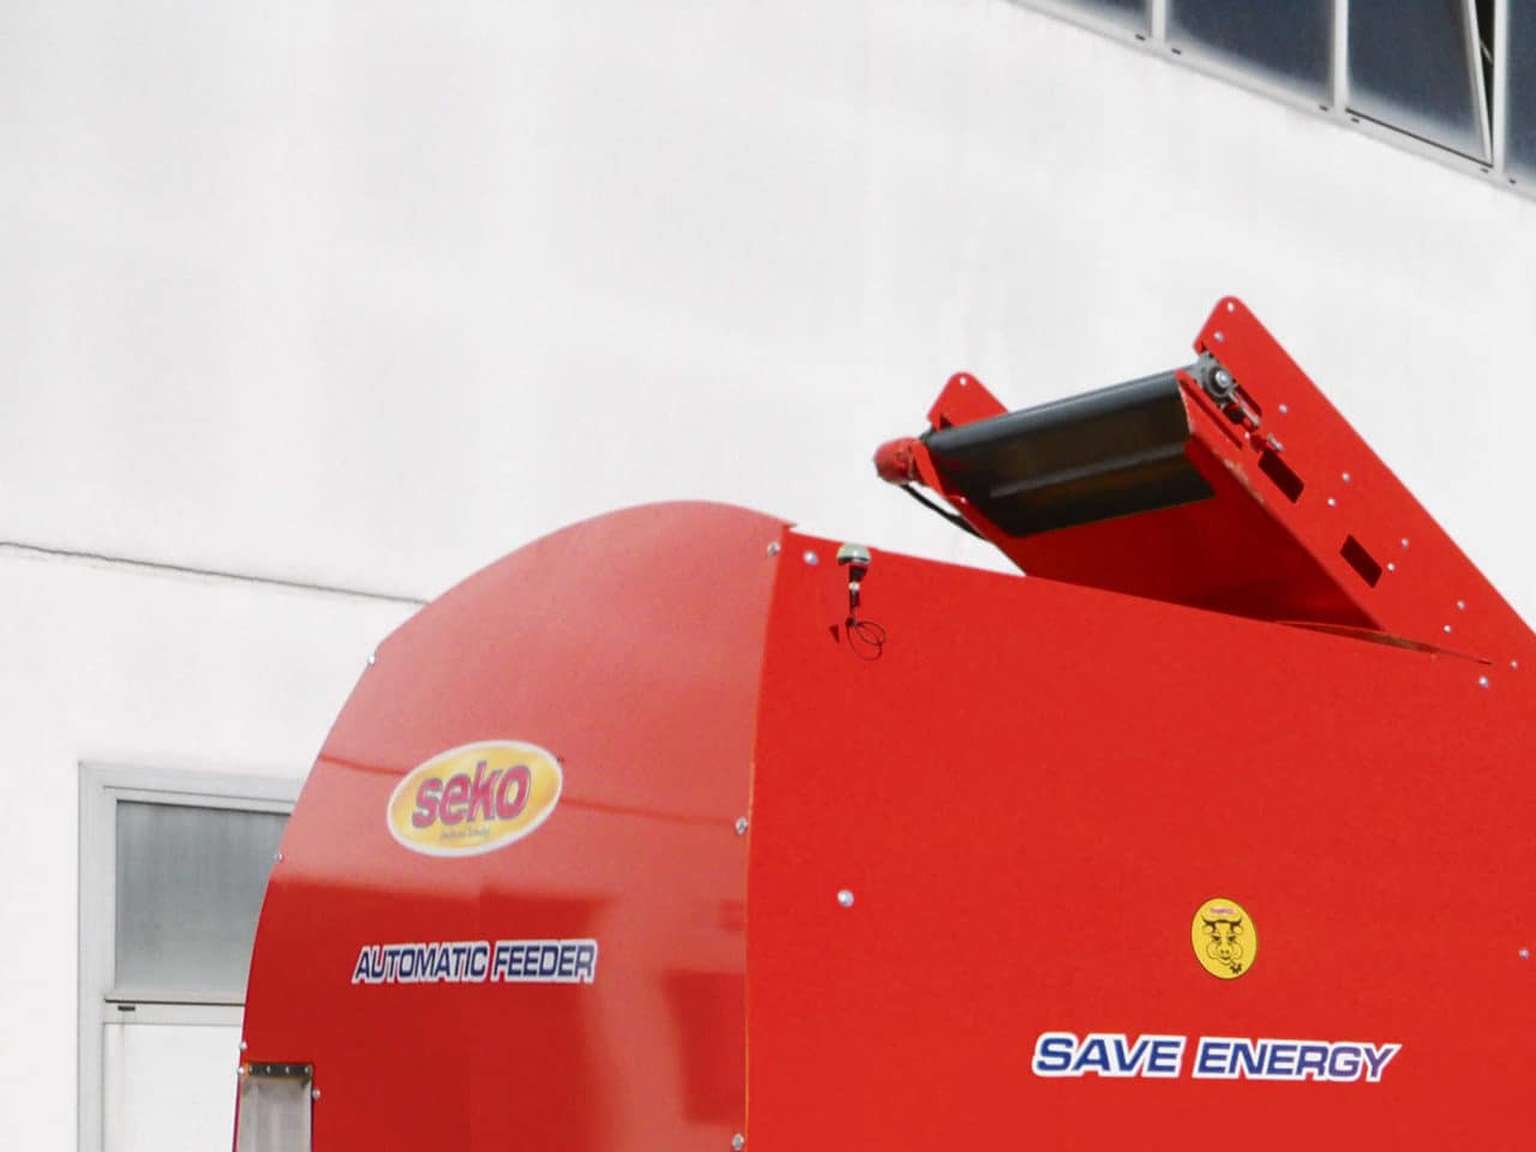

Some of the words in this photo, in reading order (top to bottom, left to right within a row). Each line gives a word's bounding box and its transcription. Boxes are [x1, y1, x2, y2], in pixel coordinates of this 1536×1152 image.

[411, 760, 532, 829] seko
[353, 942, 491, 983] AUTOMATIC
[491, 939, 598, 984] FEEDER
[1033, 1031, 1186, 1078] SAVE
[1192, 1036, 1401, 1083] ENERGY
